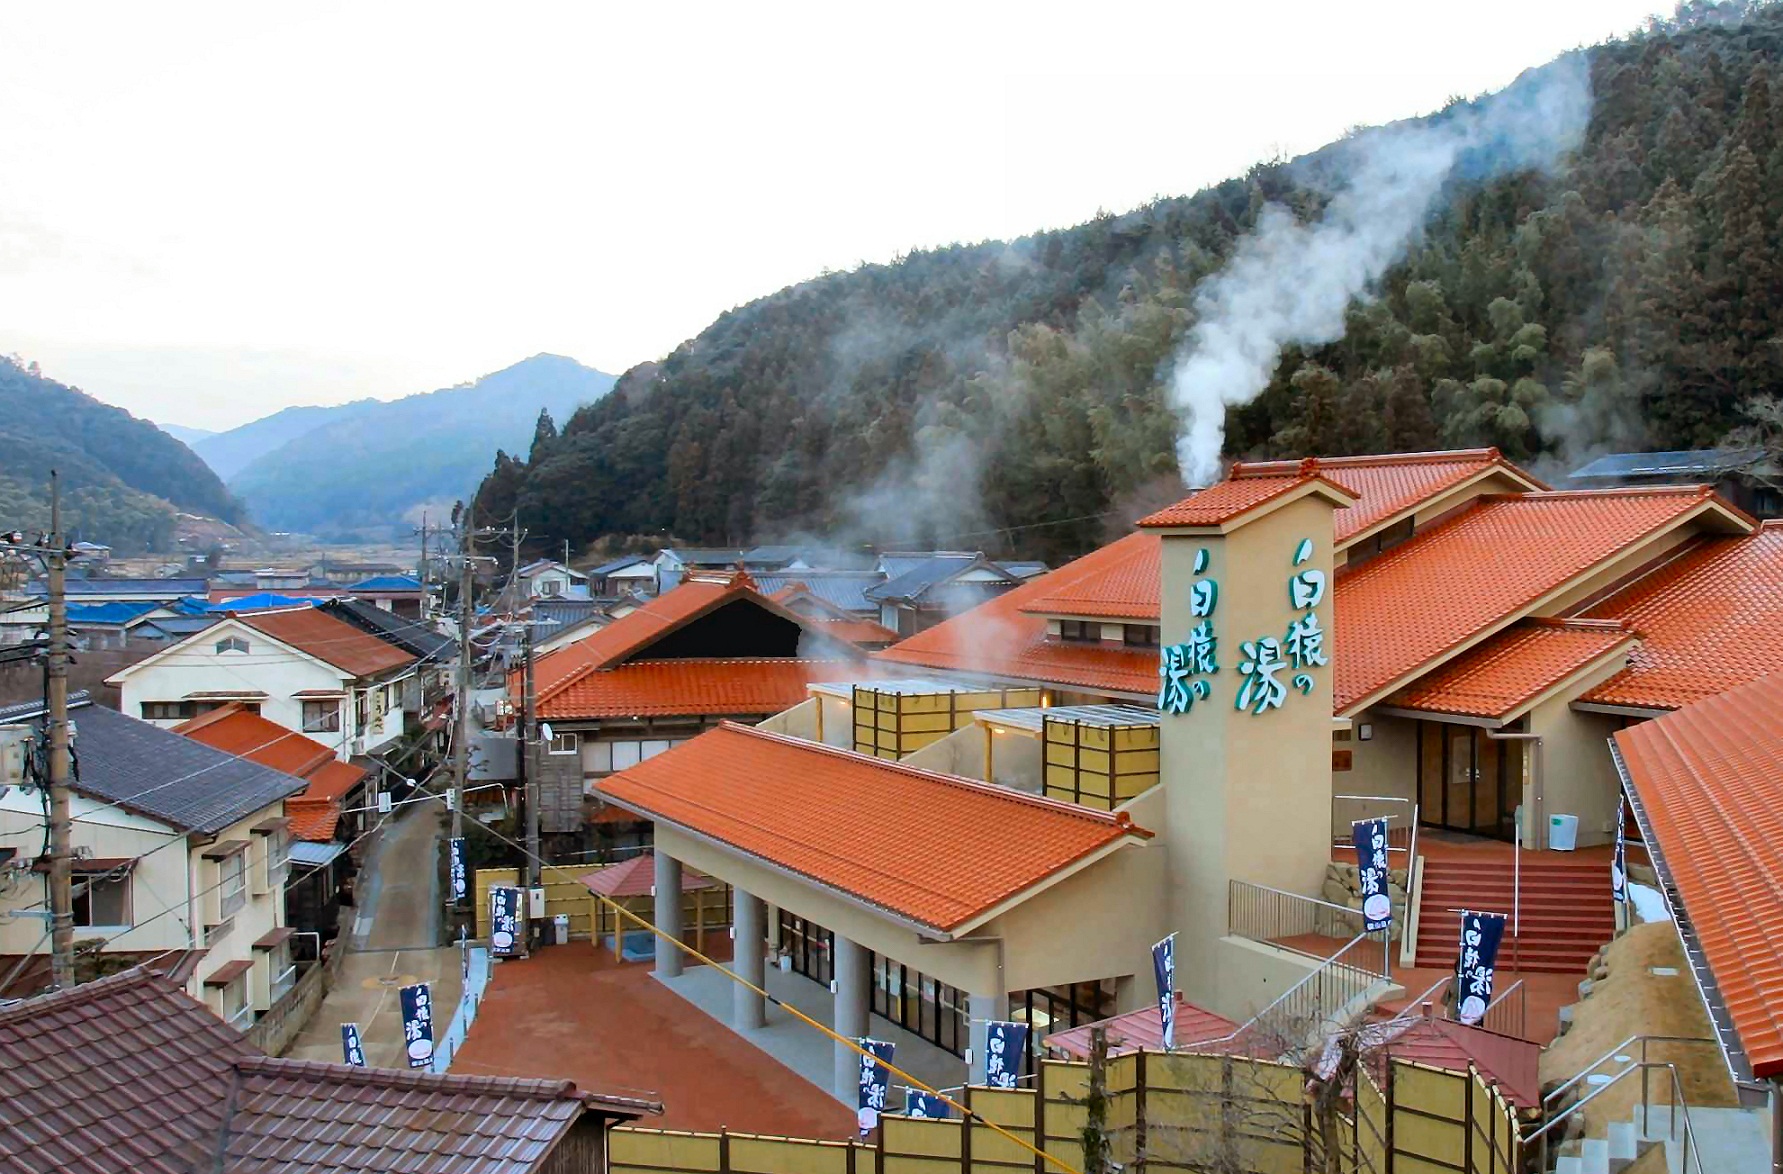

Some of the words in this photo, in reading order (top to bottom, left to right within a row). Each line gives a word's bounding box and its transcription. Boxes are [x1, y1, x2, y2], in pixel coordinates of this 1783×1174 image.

[1158, 548, 1219, 715] 白猿の湯
[1236, 538, 1328, 715] 白猿の湯
[1361, 824, 1388, 895] 白猿の湯
